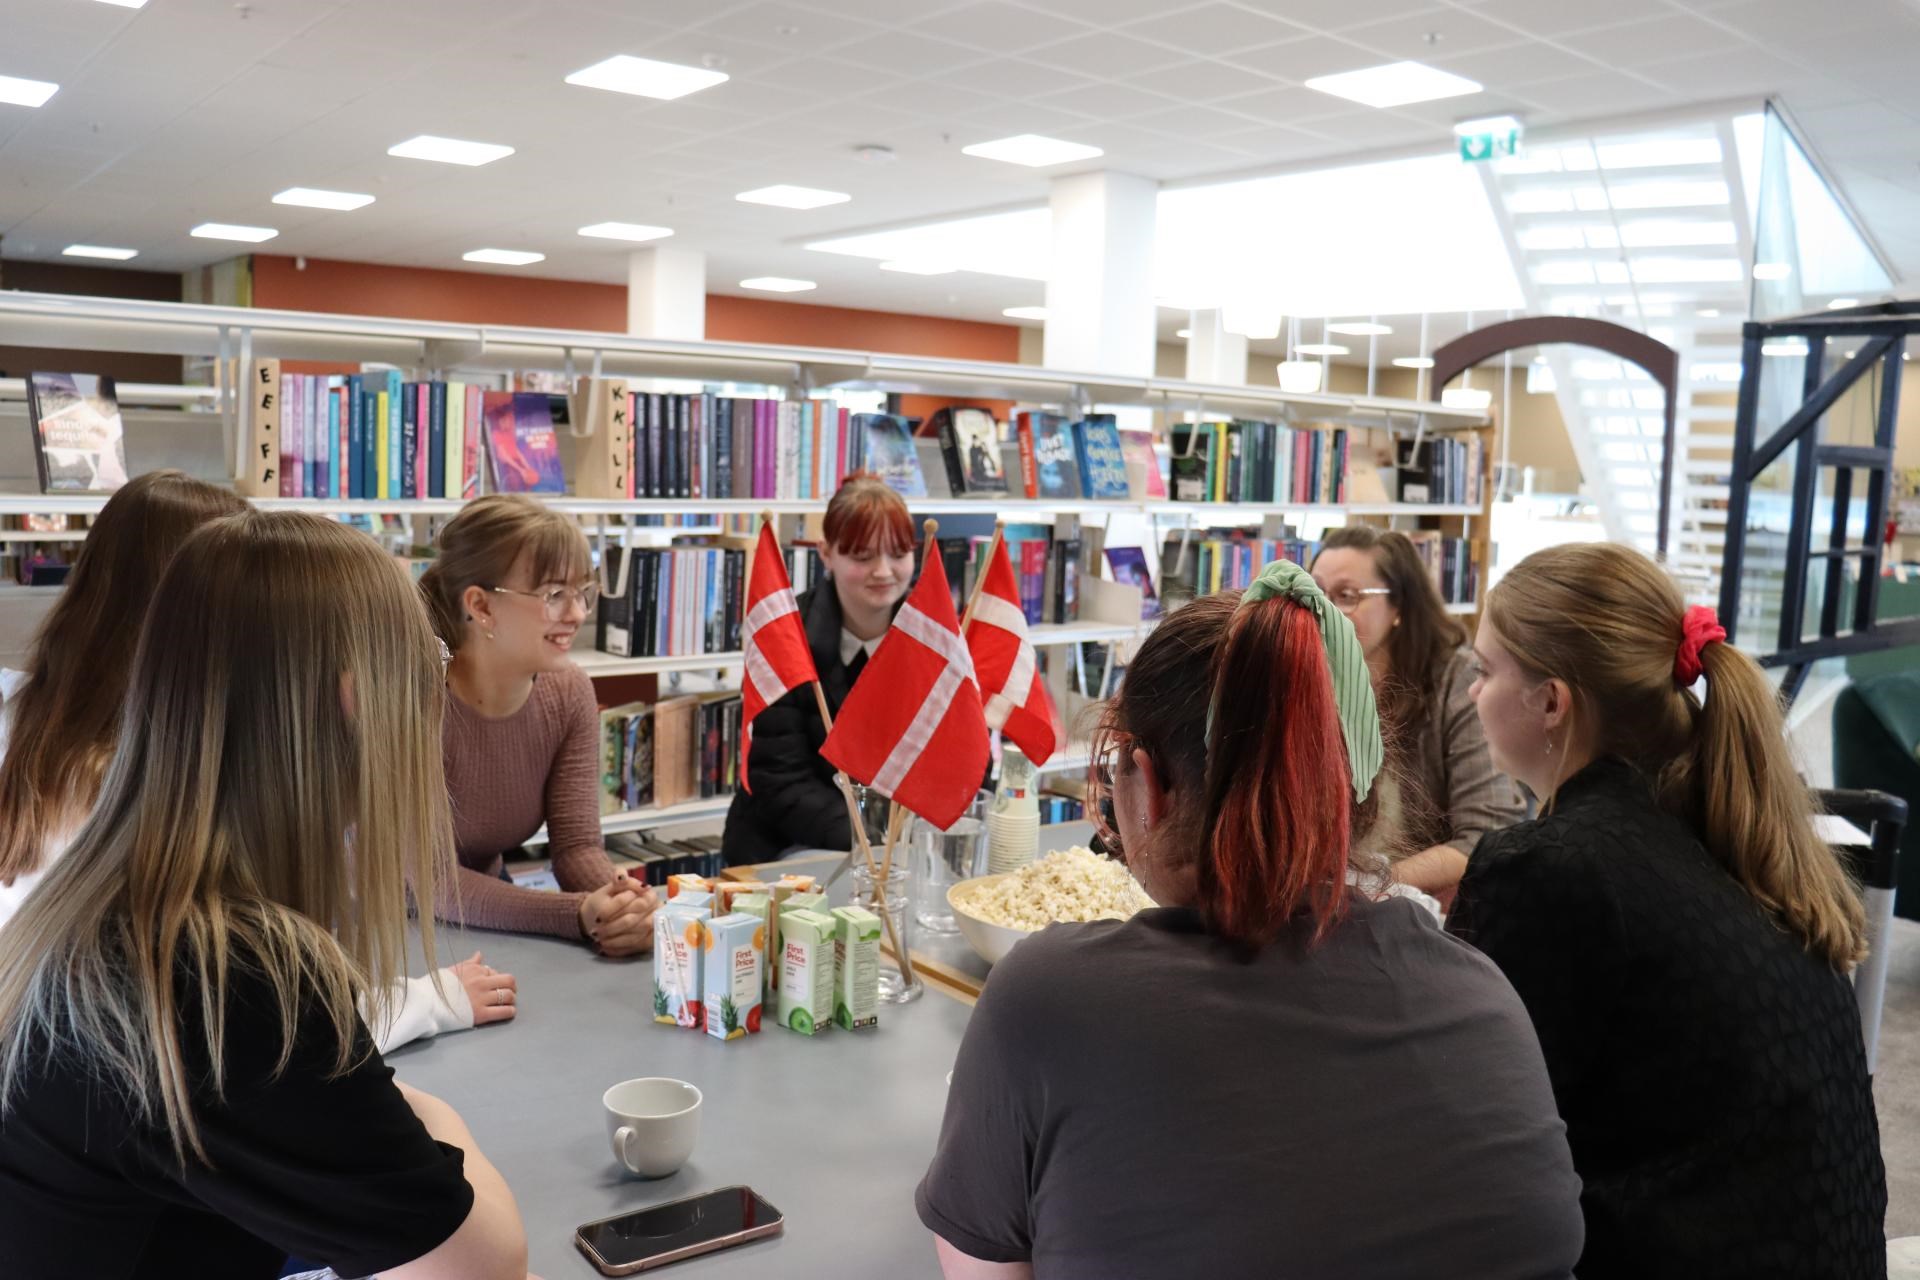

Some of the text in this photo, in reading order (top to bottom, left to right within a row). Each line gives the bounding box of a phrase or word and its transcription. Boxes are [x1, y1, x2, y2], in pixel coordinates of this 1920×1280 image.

[787, 943, 803, 954] First
[736, 950, 752, 958] First
[786, 951, 806, 963] Price
[736, 959, 755, 968] Price
